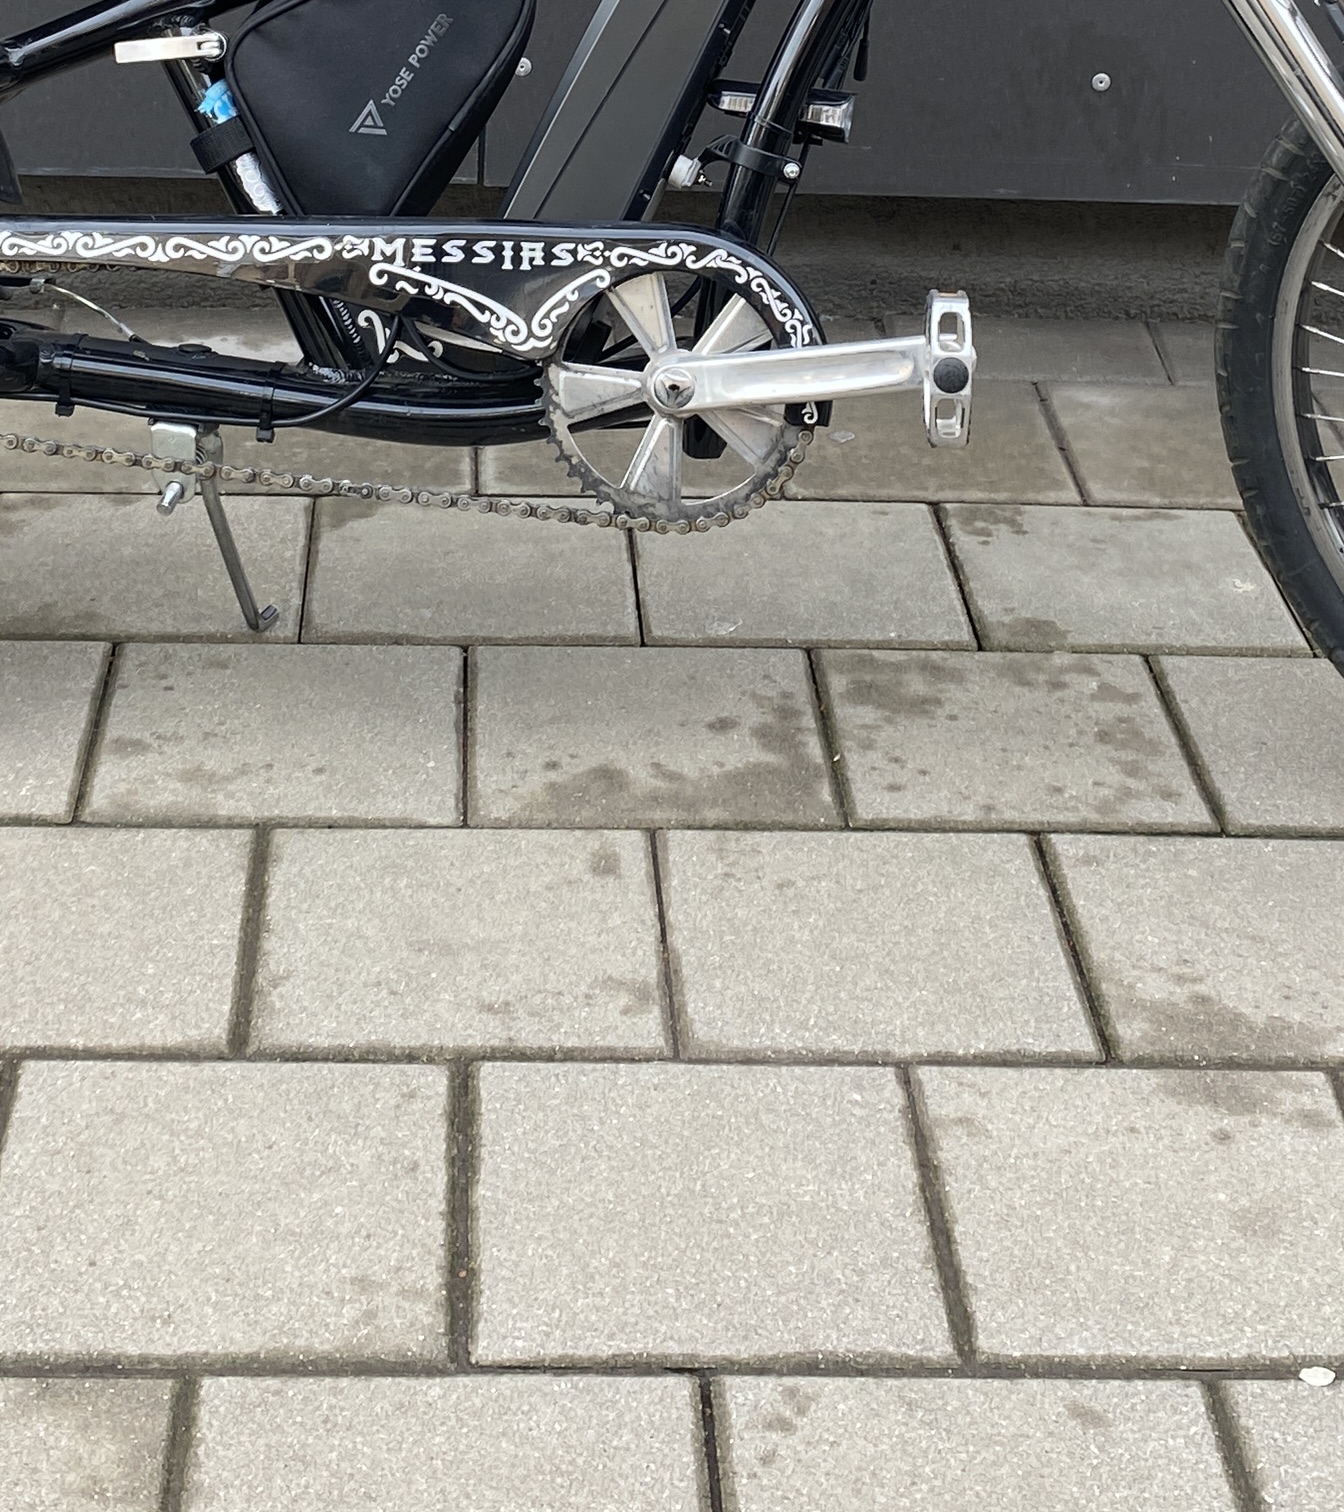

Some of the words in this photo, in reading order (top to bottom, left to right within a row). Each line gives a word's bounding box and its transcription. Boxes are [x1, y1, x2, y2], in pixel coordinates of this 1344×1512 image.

[381, 67, 414, 107] YOSE
[408, 13, 454, 68] POWER
[371, 237, 576, 270] MESSIAS
